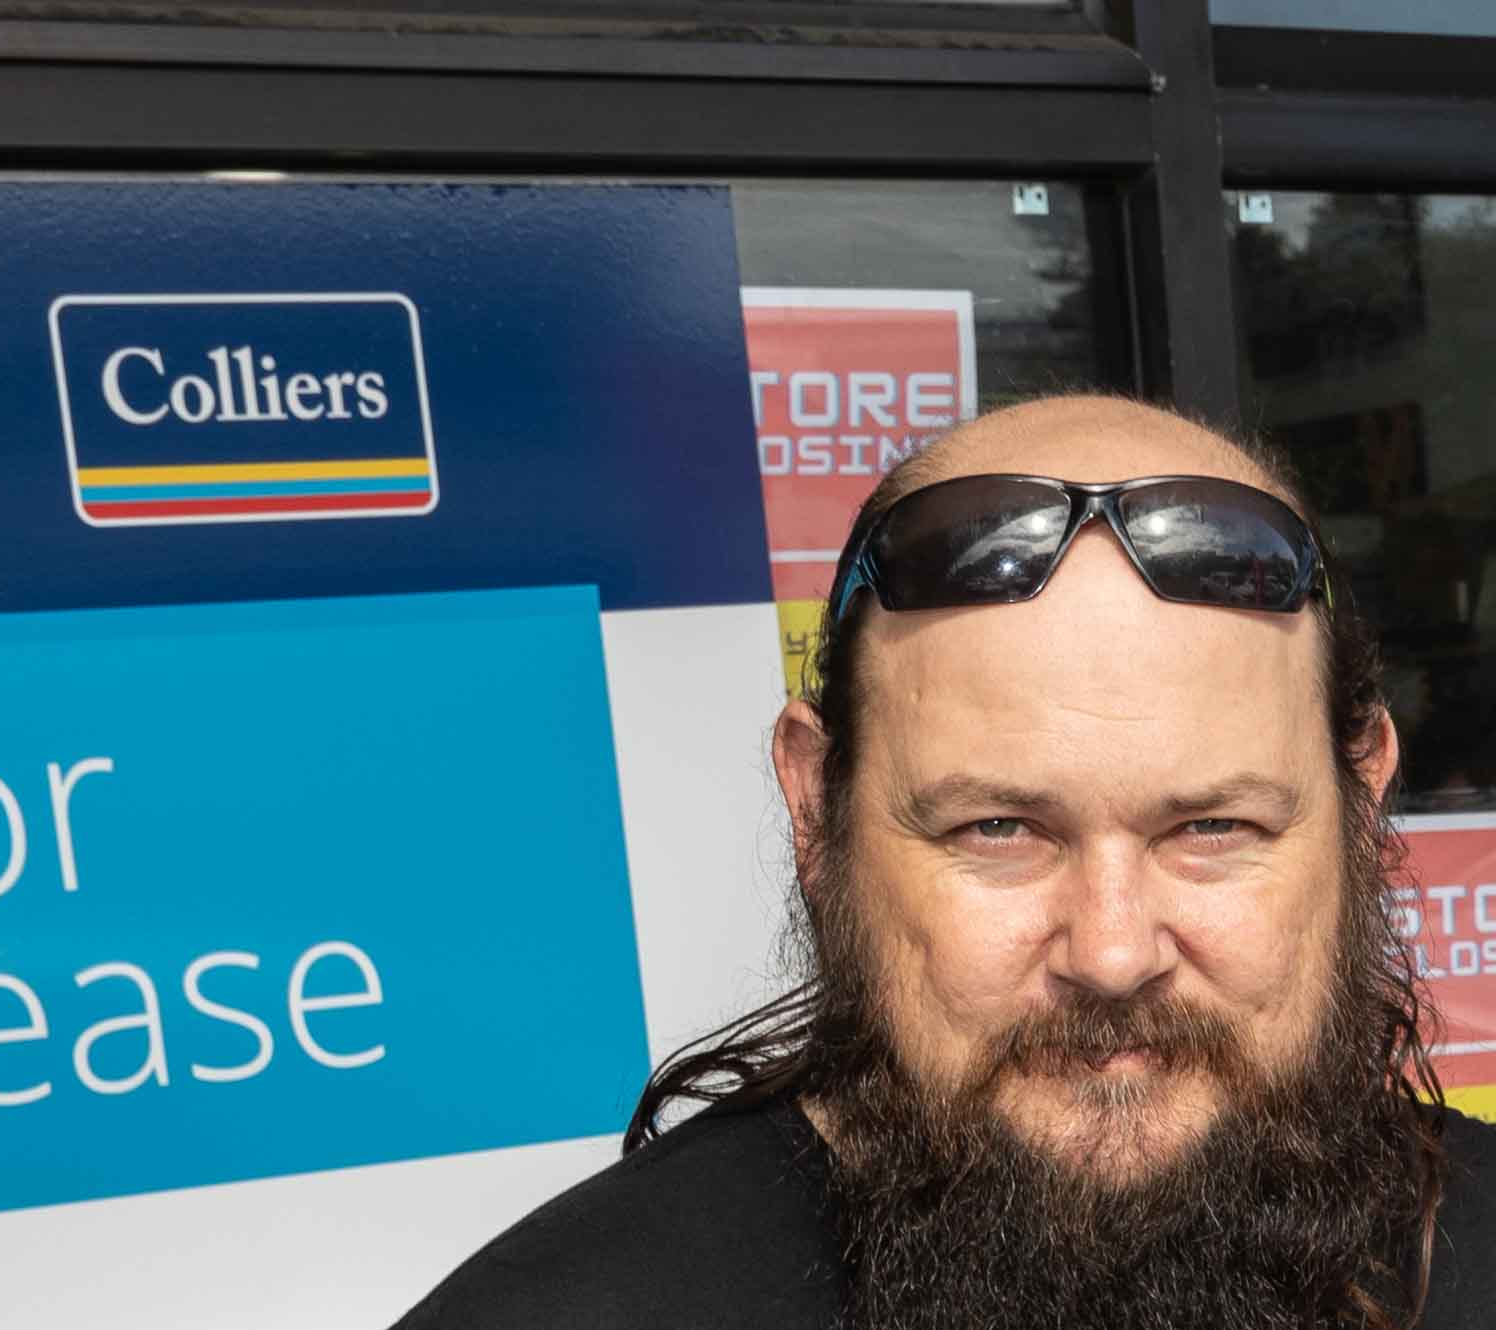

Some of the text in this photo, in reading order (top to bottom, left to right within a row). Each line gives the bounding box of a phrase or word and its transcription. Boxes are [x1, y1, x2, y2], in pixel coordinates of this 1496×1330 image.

[101, 343, 389, 425] Colliers
[750, 371, 954, 428] TORE
[758, 435, 936, 476] OSIN
